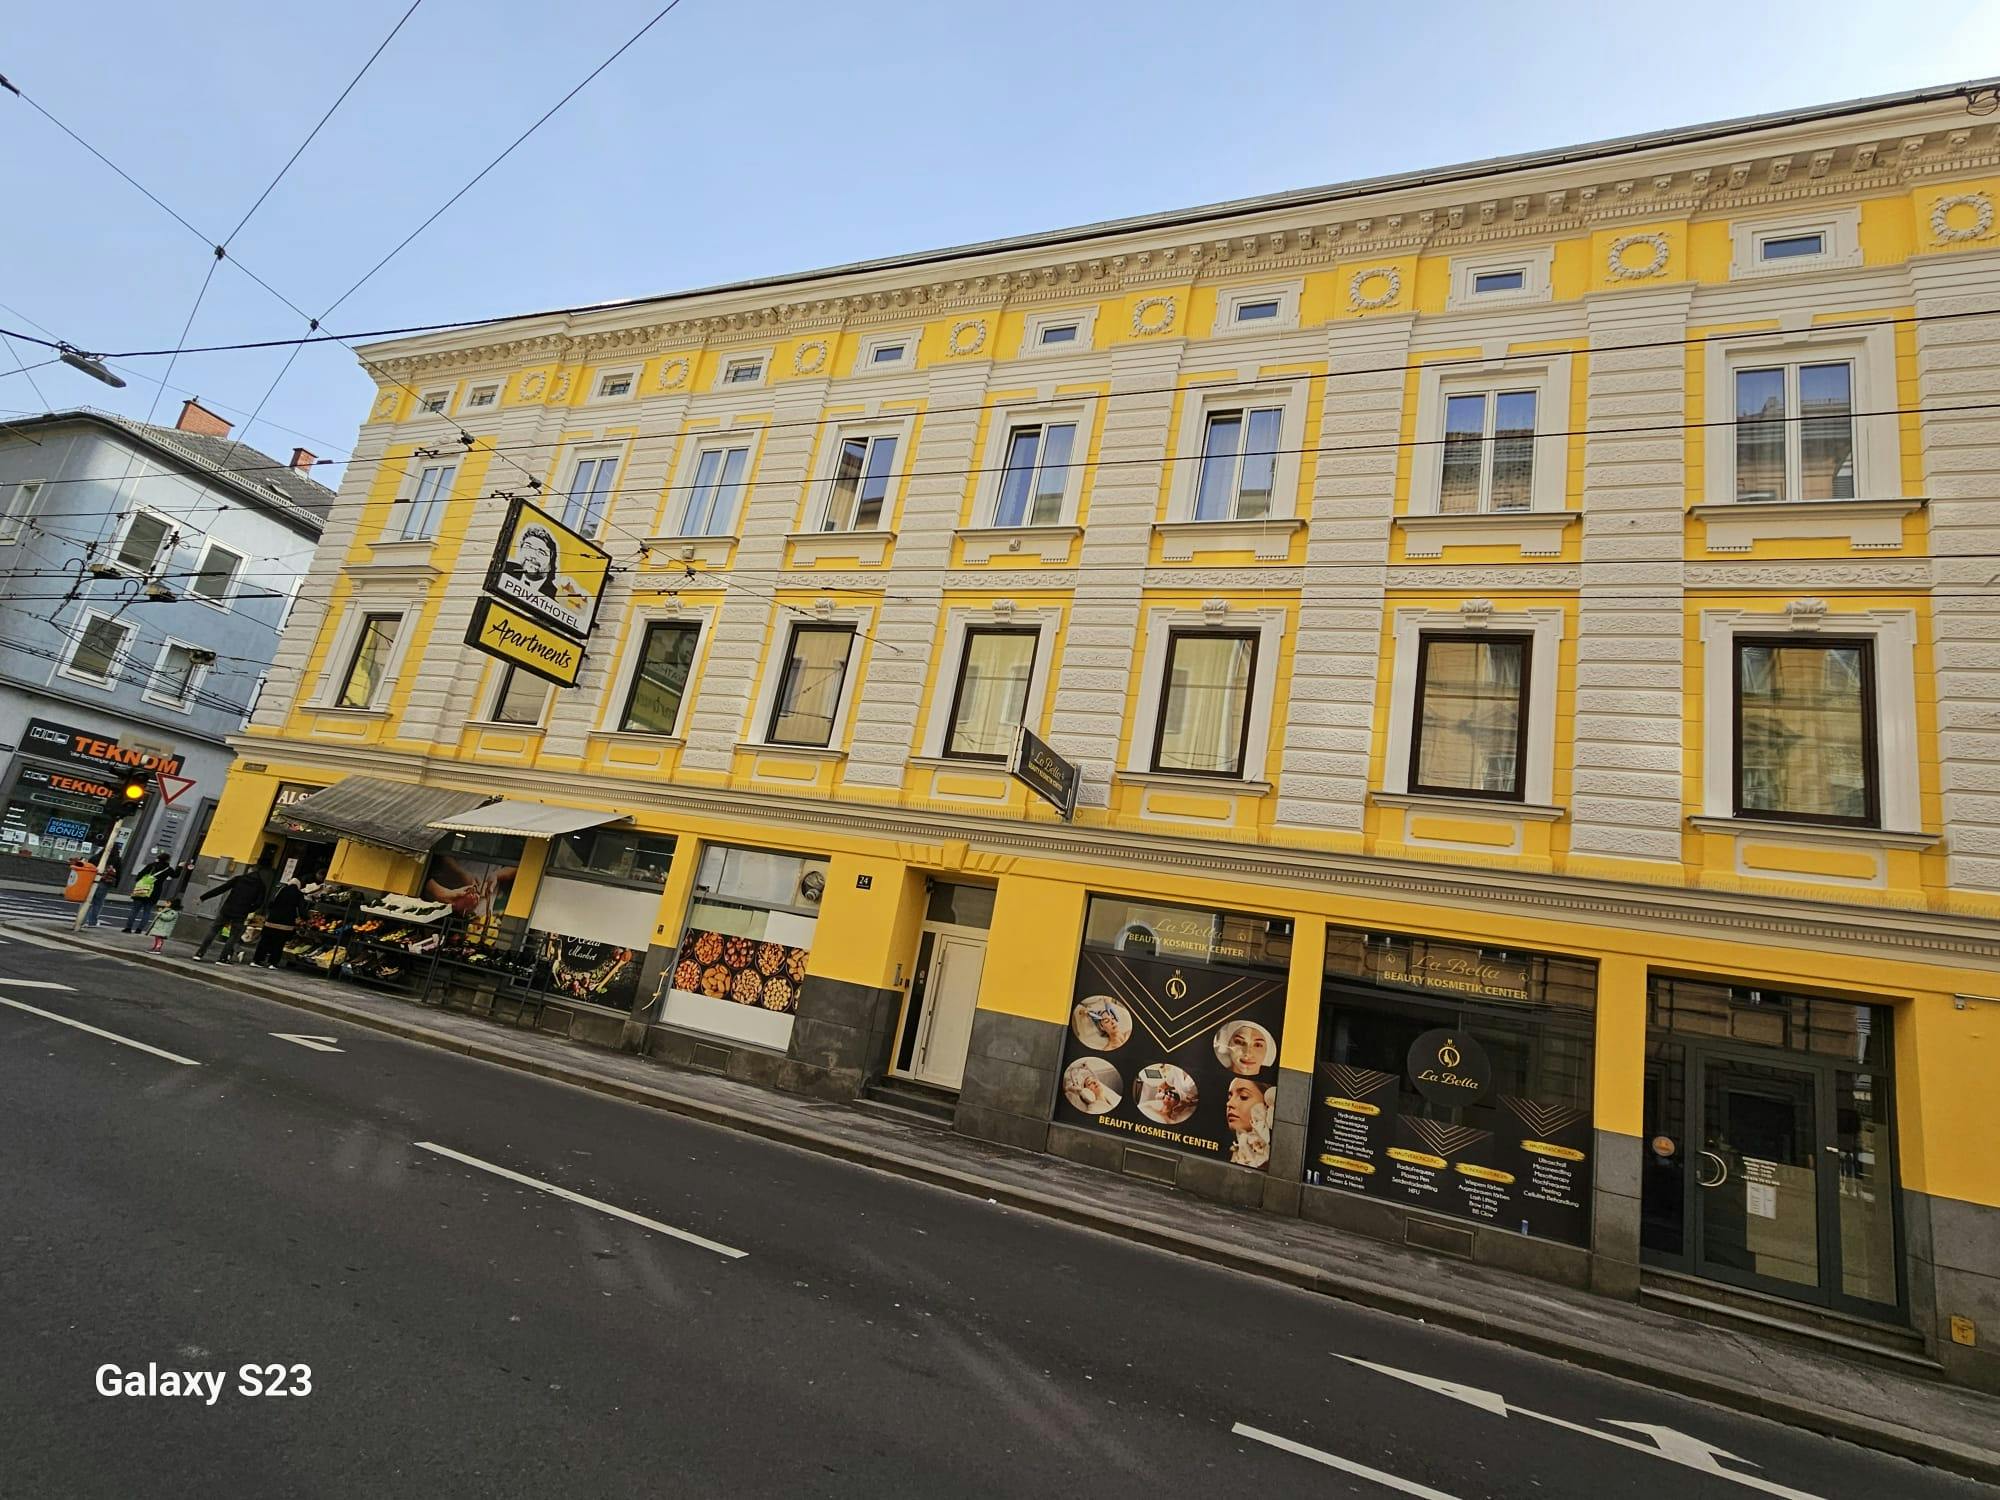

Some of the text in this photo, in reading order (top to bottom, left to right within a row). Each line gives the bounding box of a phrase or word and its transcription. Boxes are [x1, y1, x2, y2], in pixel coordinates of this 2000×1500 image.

[504, 580, 579, 629] PRIVATHOTEL
[487, 619, 572, 669] Apartments
[49, 826, 85, 838] BONUS
[859, 876, 869, 885] 24
[1153, 919, 1223, 938] La Bella
[1128, 933, 1244, 957] BEAUTY KOSMETIK CENTER
[1412, 955, 1500, 980] La Bella
[1384, 970, 1529, 1000] BEAUTY KOSMETIK CENTER
[1418, 1069, 1479, 1089] La Bella
[1098, 1115, 1219, 1151] BEAUTY KOSMETIK CENTER
